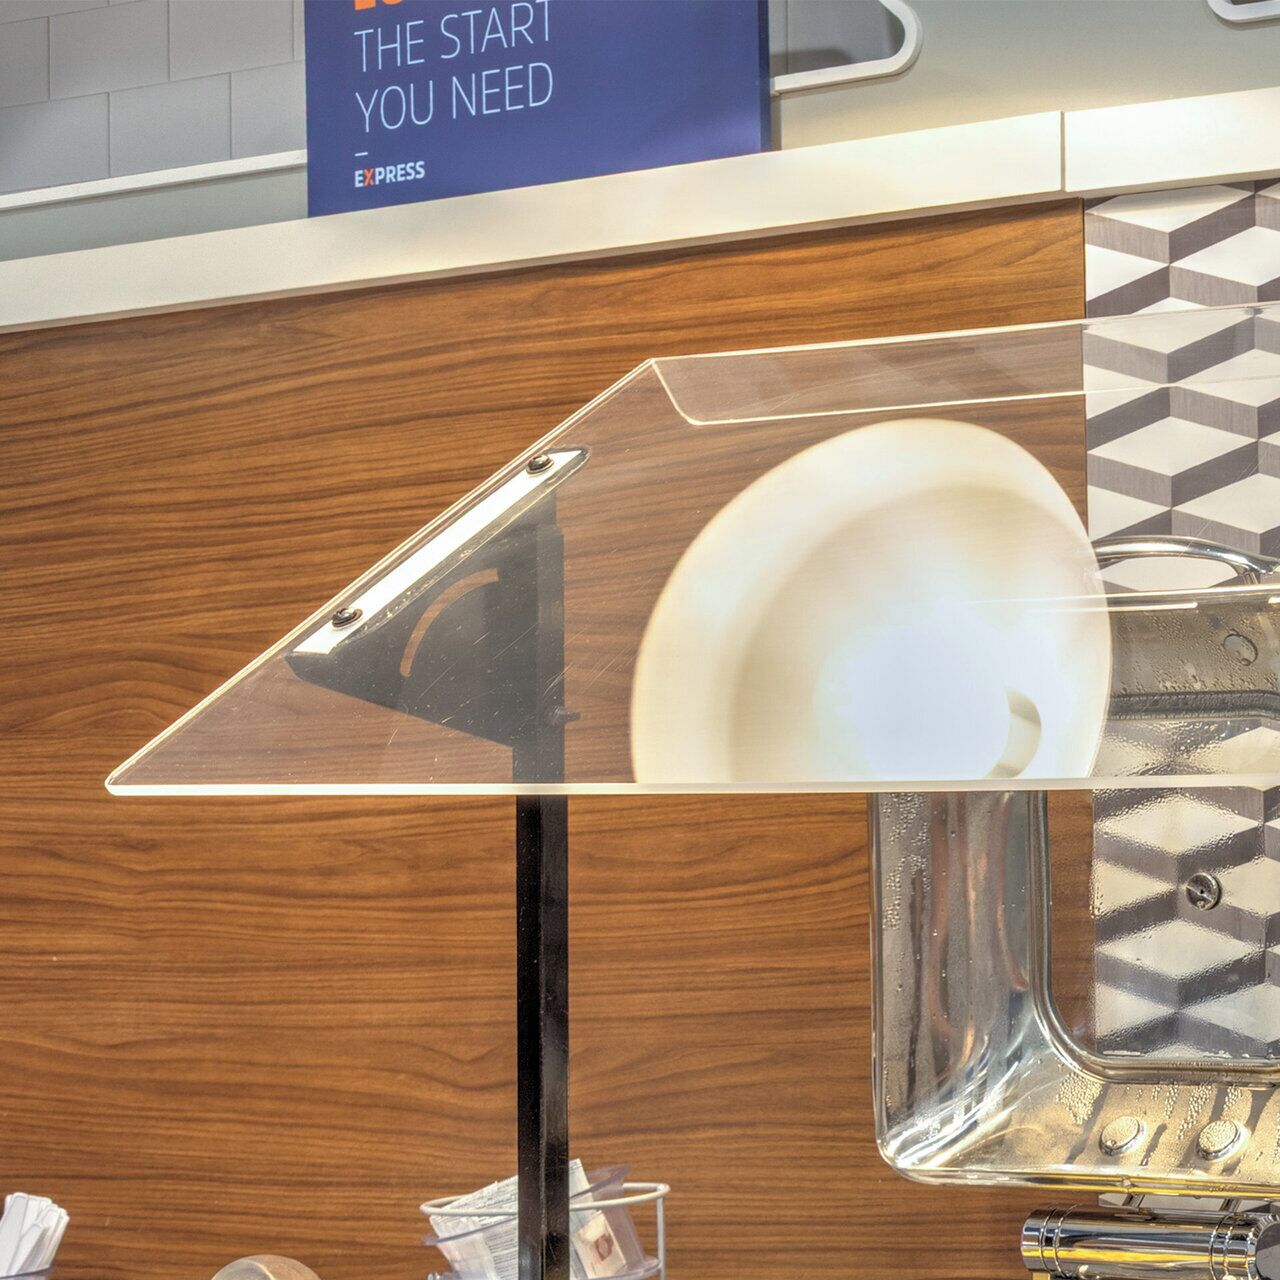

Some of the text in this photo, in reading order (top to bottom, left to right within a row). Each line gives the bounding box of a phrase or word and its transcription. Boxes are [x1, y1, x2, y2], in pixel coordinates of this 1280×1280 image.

[353, 0, 550, 73] THE START
[355, 62, 553, 133] YOU NEED
[354, 160, 426, 188] EXPRESS
